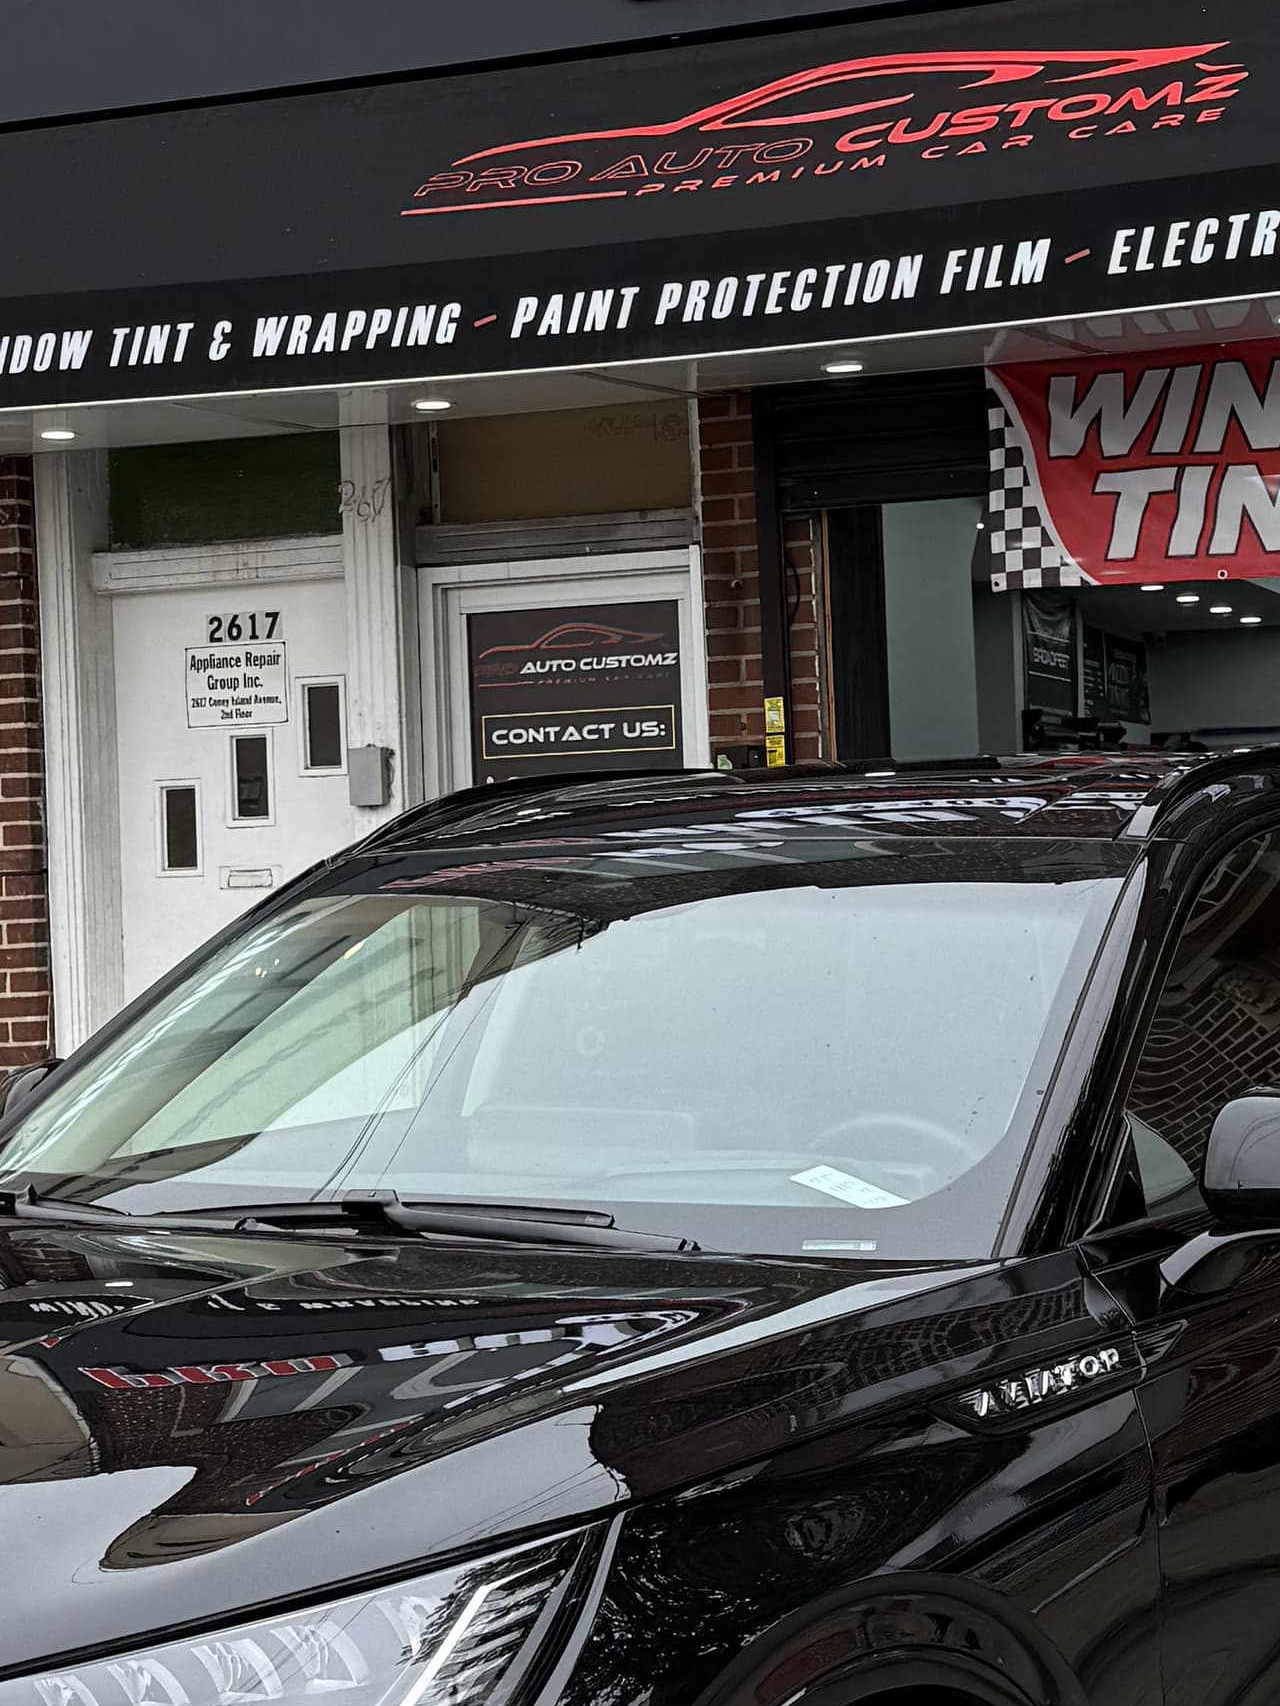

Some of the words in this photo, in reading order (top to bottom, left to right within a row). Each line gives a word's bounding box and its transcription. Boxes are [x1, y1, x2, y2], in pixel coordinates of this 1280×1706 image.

[413, 156, 583, 200] PRO
[588, 137, 815, 182] AUTO
[834, 61, 1251, 155] CUSTOMZ
[634, 154, 887, 198] PREMIUM
[920, 134, 1033, 162] CAR
[1069, 106, 1226, 144] CARE
[109, 322, 195, 369] TINT
[207, 320, 232, 361] &
[252, 302, 463, 358] WRAPPING
[511, 287, 640, 339] PAINT
[655, 255, 924, 327] PROTECTION
[939, 238, 1052, 294] FILM
[208, 611, 280, 644] 2617
[190, 652, 242, 673] Appliance
[245, 649, 281, 669] Repair
[520, 659, 576, 674] AUTO
[579, 651, 679, 671] CUSTOMZ
[207, 674, 240, 691] Group
[243, 672, 264, 689] Inc.
[491, 723, 616, 746] CONTACT
[623, 720, 666, 739] US:
